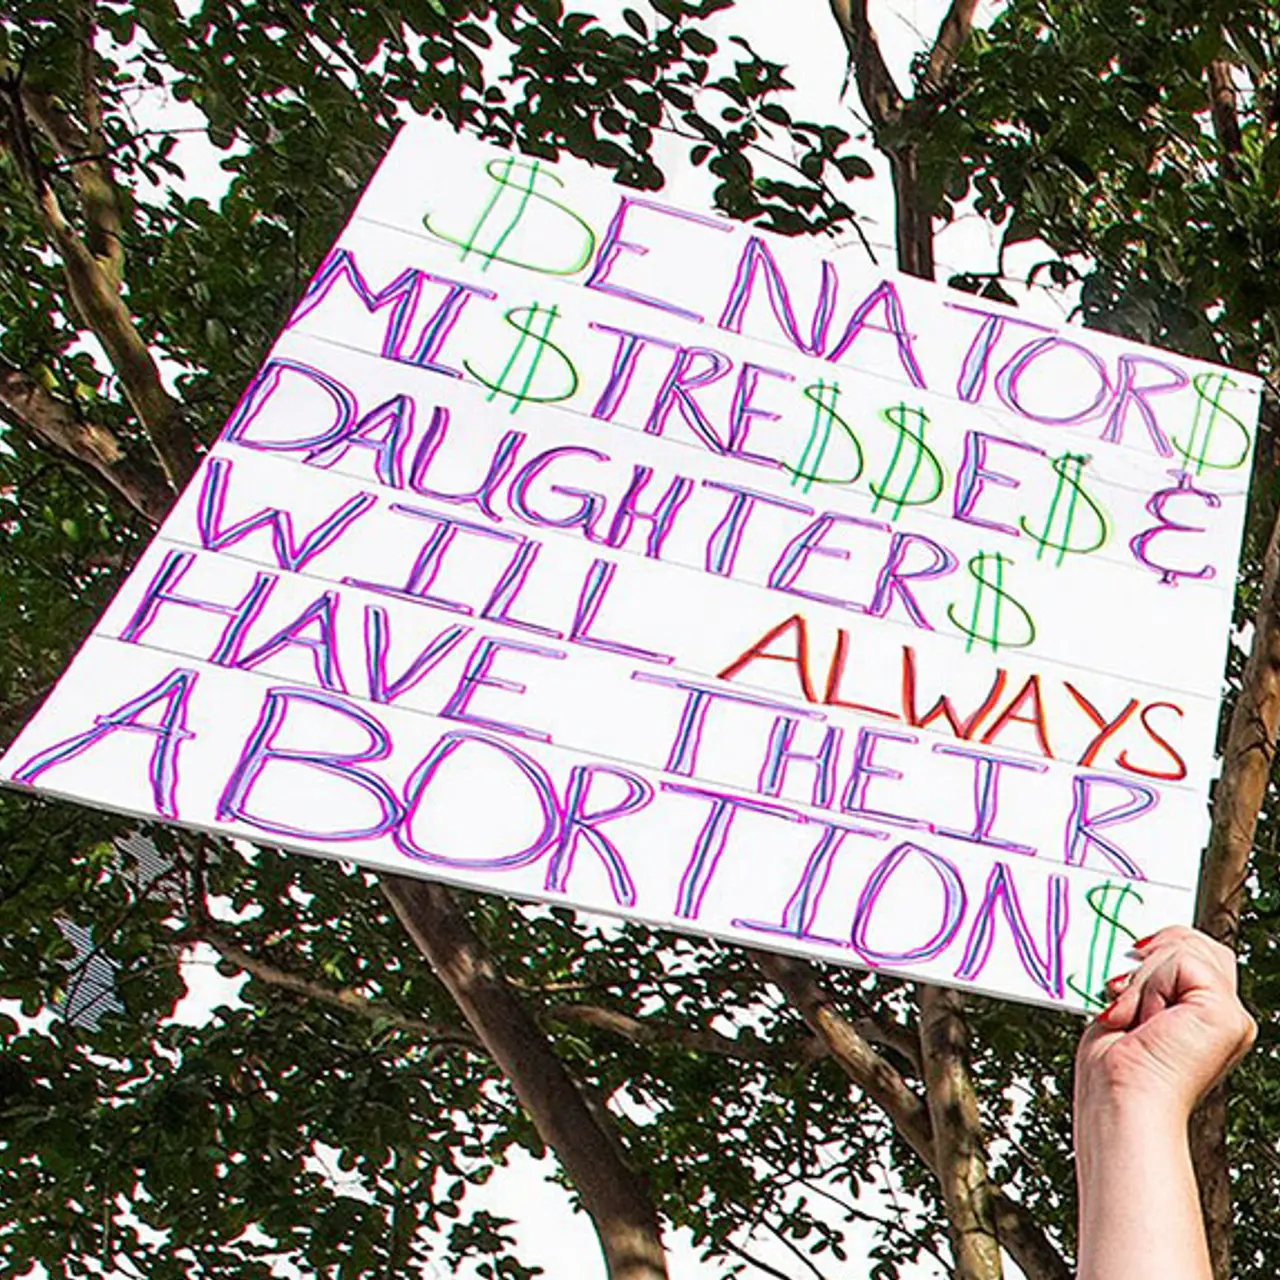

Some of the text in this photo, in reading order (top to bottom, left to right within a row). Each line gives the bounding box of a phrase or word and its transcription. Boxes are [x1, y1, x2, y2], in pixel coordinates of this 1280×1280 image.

[197, 455, 1187, 781] WILL ALWAYS
[219, 356, 1036, 652] DAUGHTER$
[1130, 467, 1222, 585] &
[118, 550, 1161, 881] HAVE THEIR
